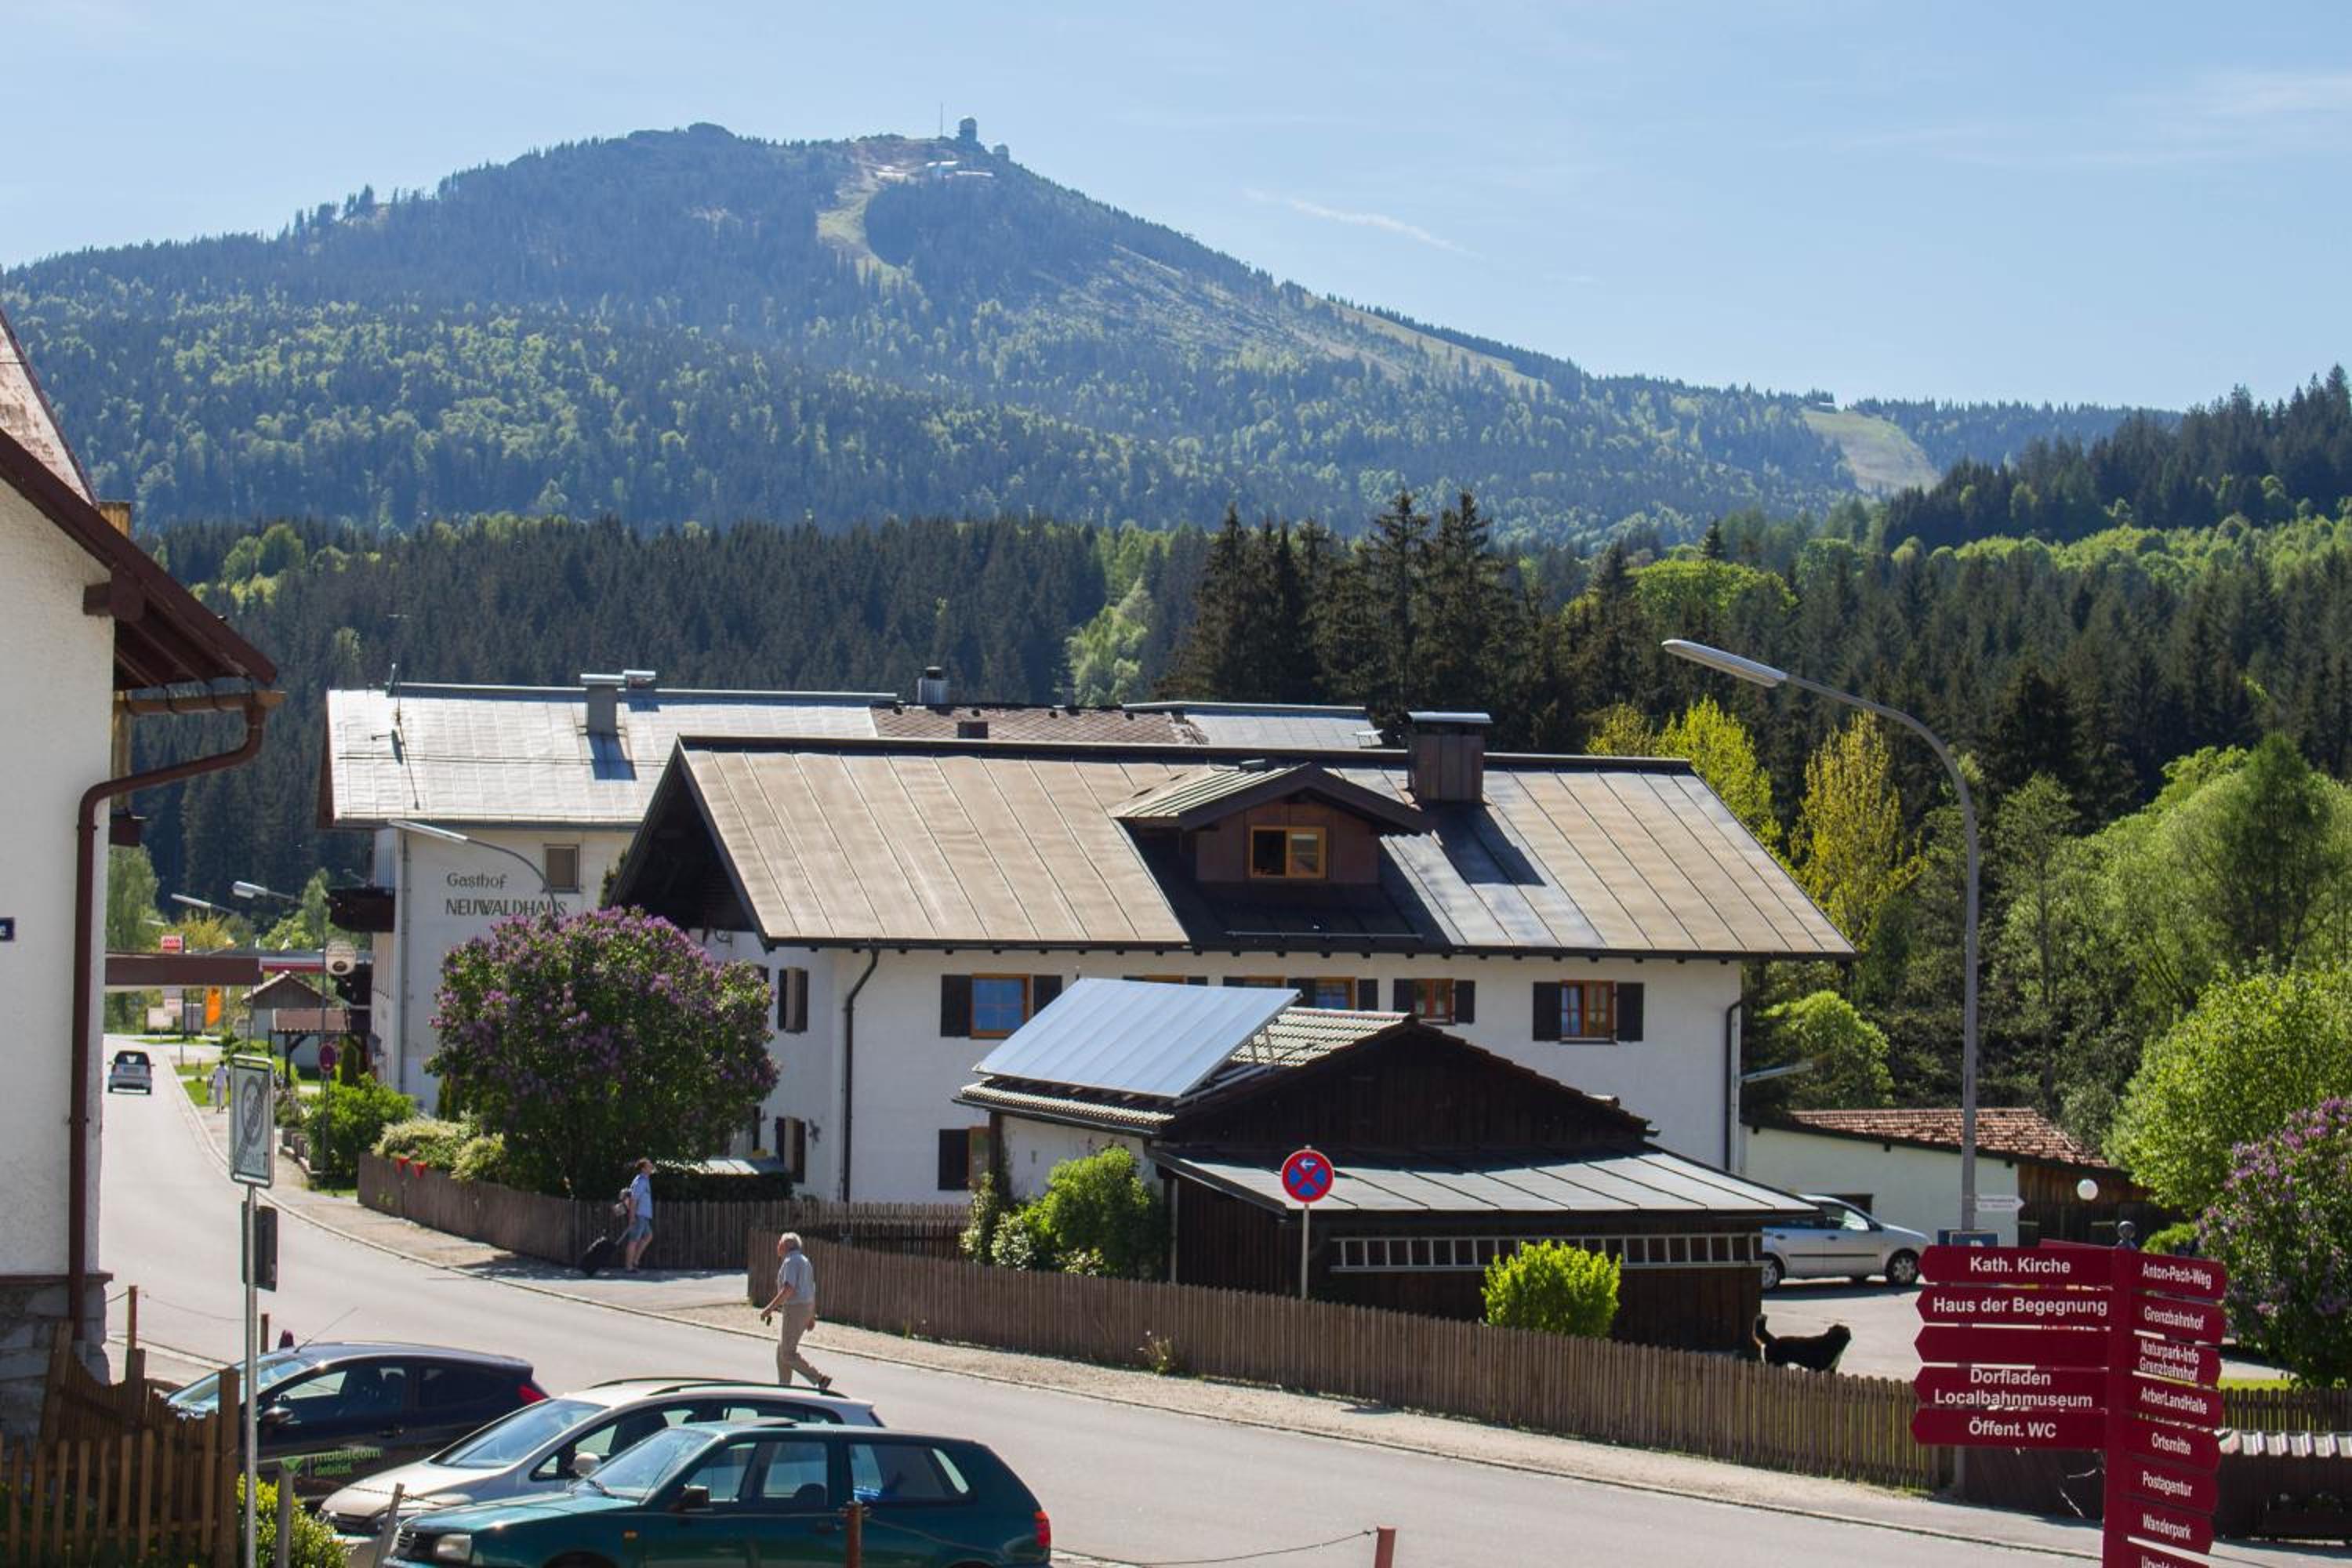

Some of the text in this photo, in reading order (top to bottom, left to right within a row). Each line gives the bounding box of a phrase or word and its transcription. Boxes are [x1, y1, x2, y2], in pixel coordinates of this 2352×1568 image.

[447, 872, 508, 889] Gasthof
[1969, 1257, 2071, 1274] Kath. Kirche
[2142, 1261, 2212, 1290] Anton-Pech-Weg
[1933, 1297, 2108, 1317] Haus der Begegnung
[2144, 1305, 2205, 1330] Grenzbahnhof
[2140, 1338, 2199, 1365] Naturpark-Info
[1969, 1368, 2051, 1386] Dorfladen
[2139, 1356, 2198, 1382] Grenzbahnhof
[1934, 1388, 2093, 1409] Localbahnmuseum
[2140, 1386, 2208, 1415] ArberLandHalle
[1969, 1420, 2057, 1438] Öffent. WC
[2151, 1432, 2191, 1456] Ortsmitte
[2142, 1470, 2193, 1497] Postagentur
[2142, 1512, 2192, 1541] Wanderpark
